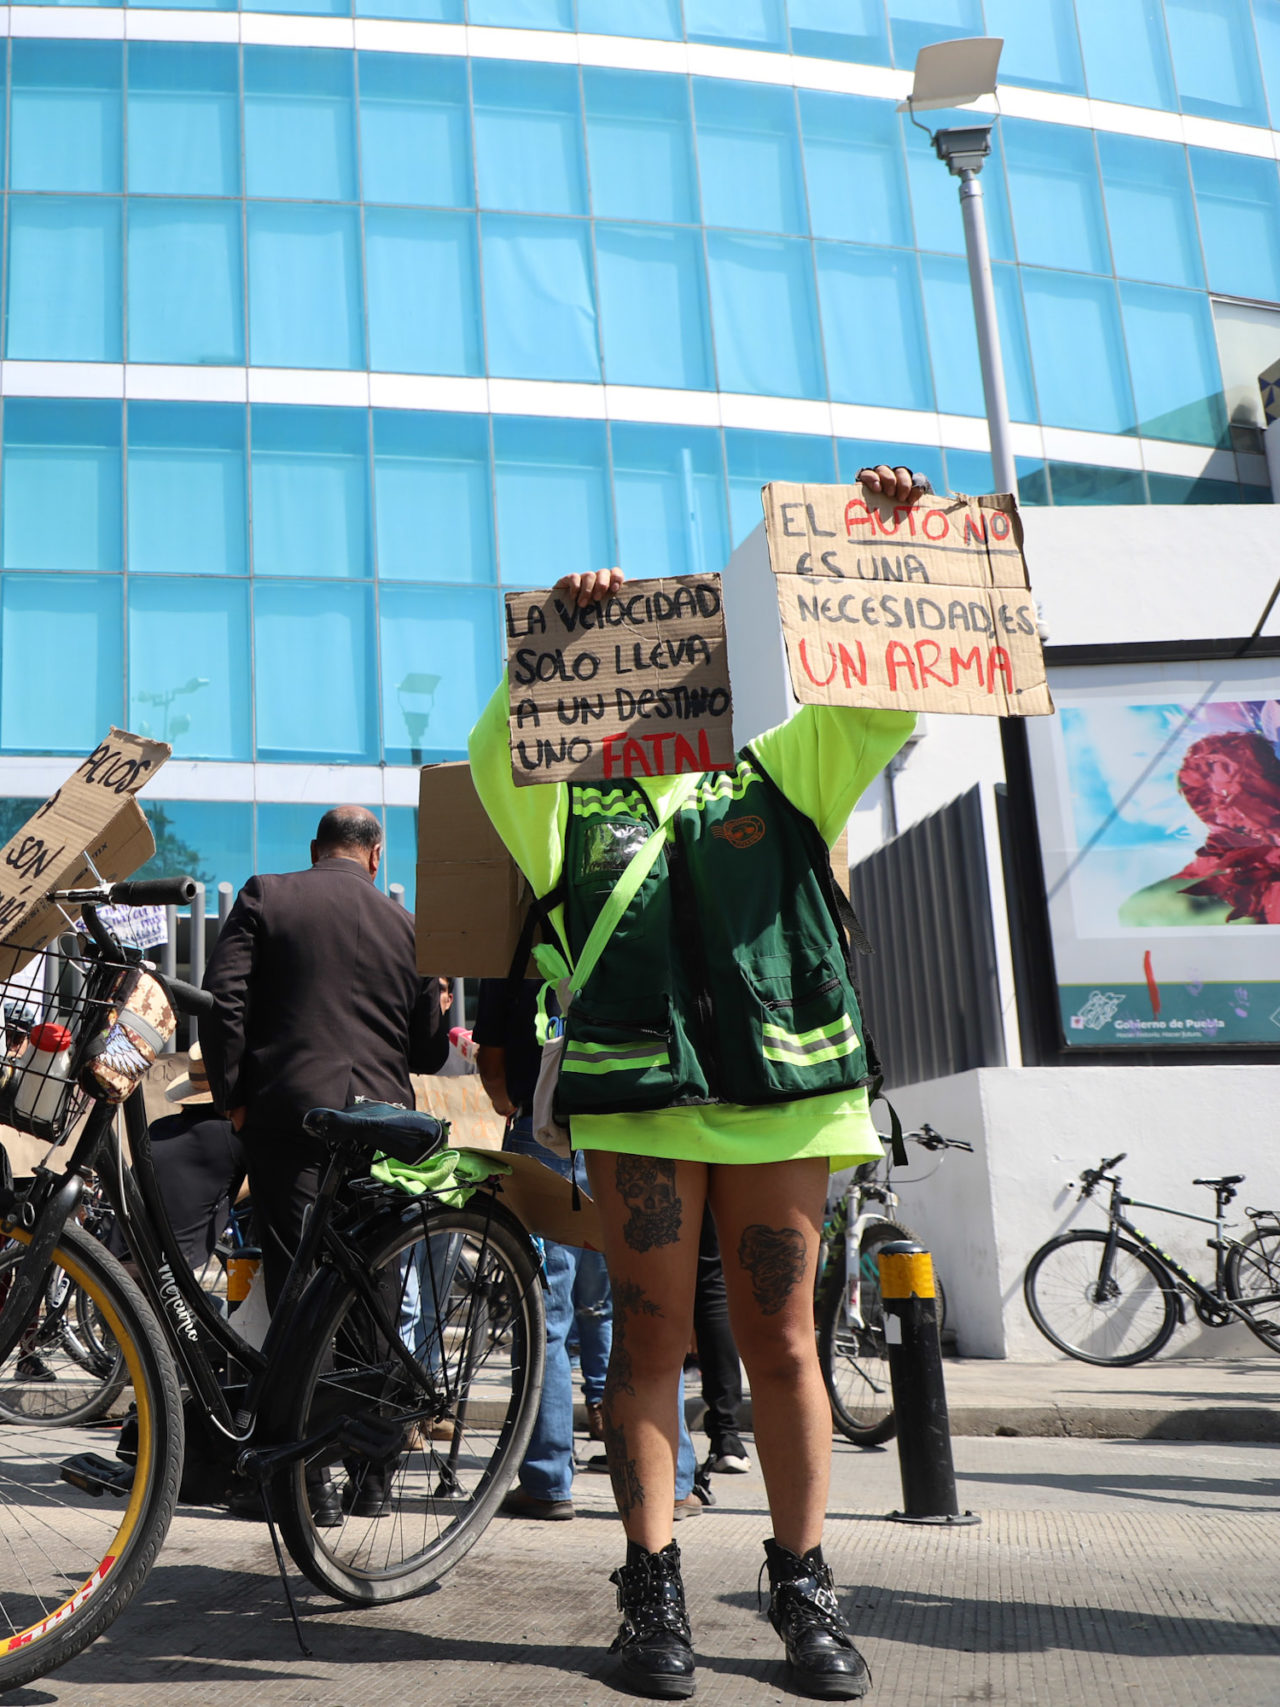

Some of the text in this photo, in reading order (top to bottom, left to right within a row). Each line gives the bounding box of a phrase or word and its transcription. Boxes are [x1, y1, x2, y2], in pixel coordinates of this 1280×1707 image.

[781, 499, 1010, 545] EL AUTO NO
[797, 551, 930, 585] ES UNA
[506, 603, 546, 638] LA
[999, 605, 1034, 635] ES
[515, 635, 711, 684] SOLO LLEVA
[799, 638, 1013, 694] UN ARMA
[517, 698, 540, 728] A
[557, 694, 605, 725] UN
[518, 729, 733, 779] UNO FATAL
[6, 836, 66, 879] SON
[1114, 1019, 1166, 1030] Gobierno
[1169, 1018, 1184, 1029] de
